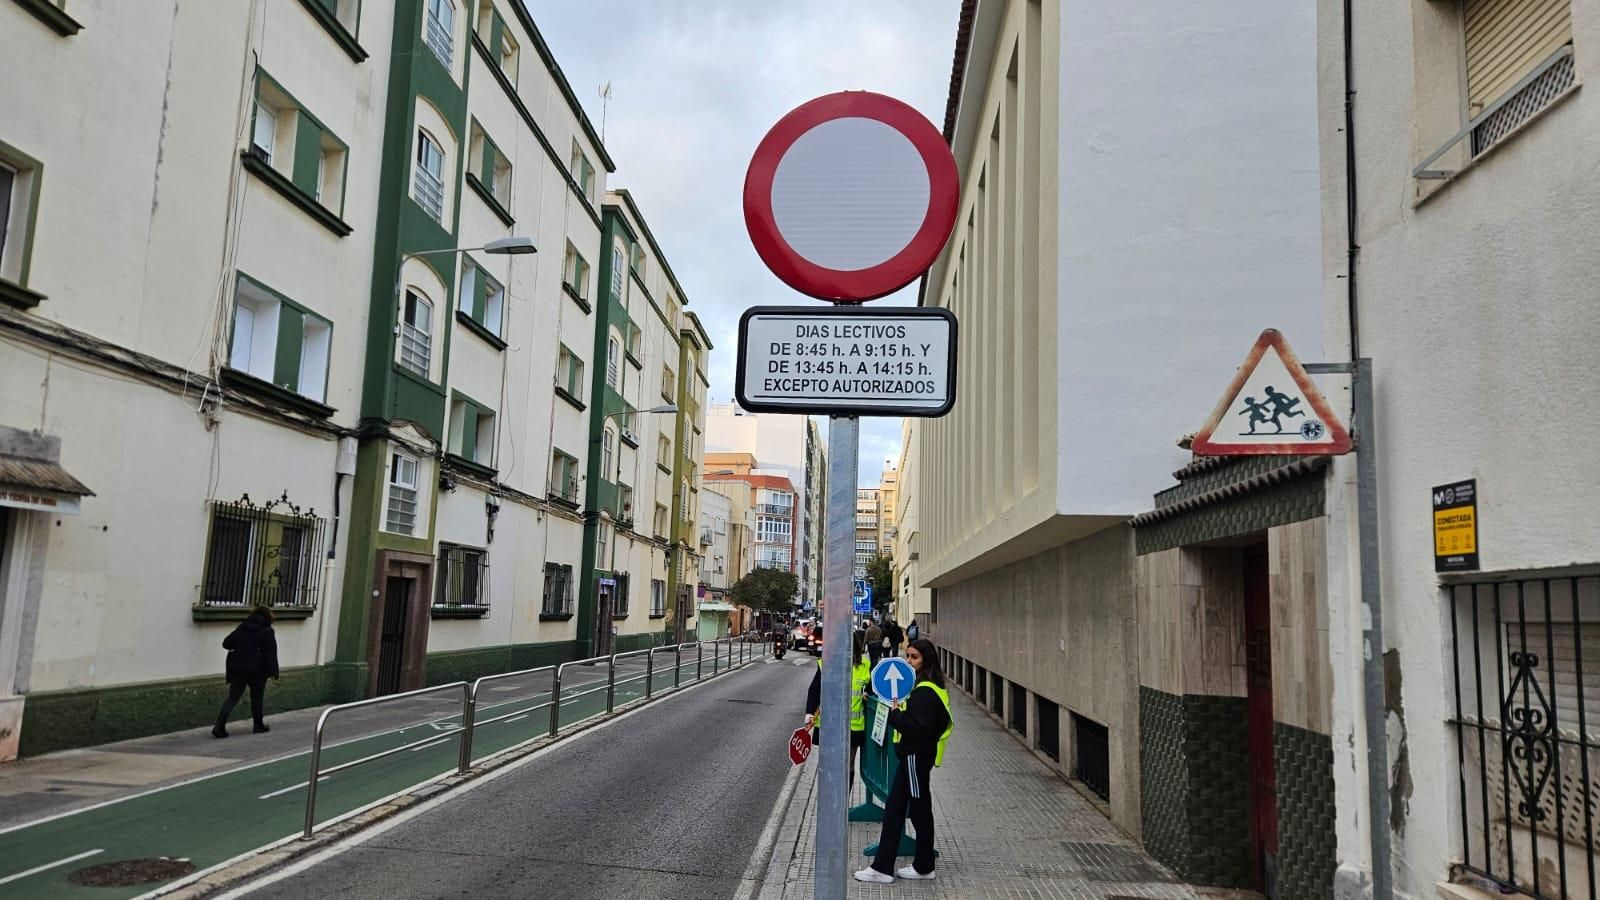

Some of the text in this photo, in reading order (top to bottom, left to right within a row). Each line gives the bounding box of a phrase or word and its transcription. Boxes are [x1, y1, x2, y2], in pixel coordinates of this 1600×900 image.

[796, 325, 906, 339] DIAS LECTIVOS
[770, 342, 931, 357] DE 8:45 h. A 9:15 h. Y
[768, 360, 932, 375] DE 13:45 h. A 14:15 h.
[764, 378, 935, 394] EXCEPTO AUTORIZADOS
[791, 735, 810, 759] STOP
